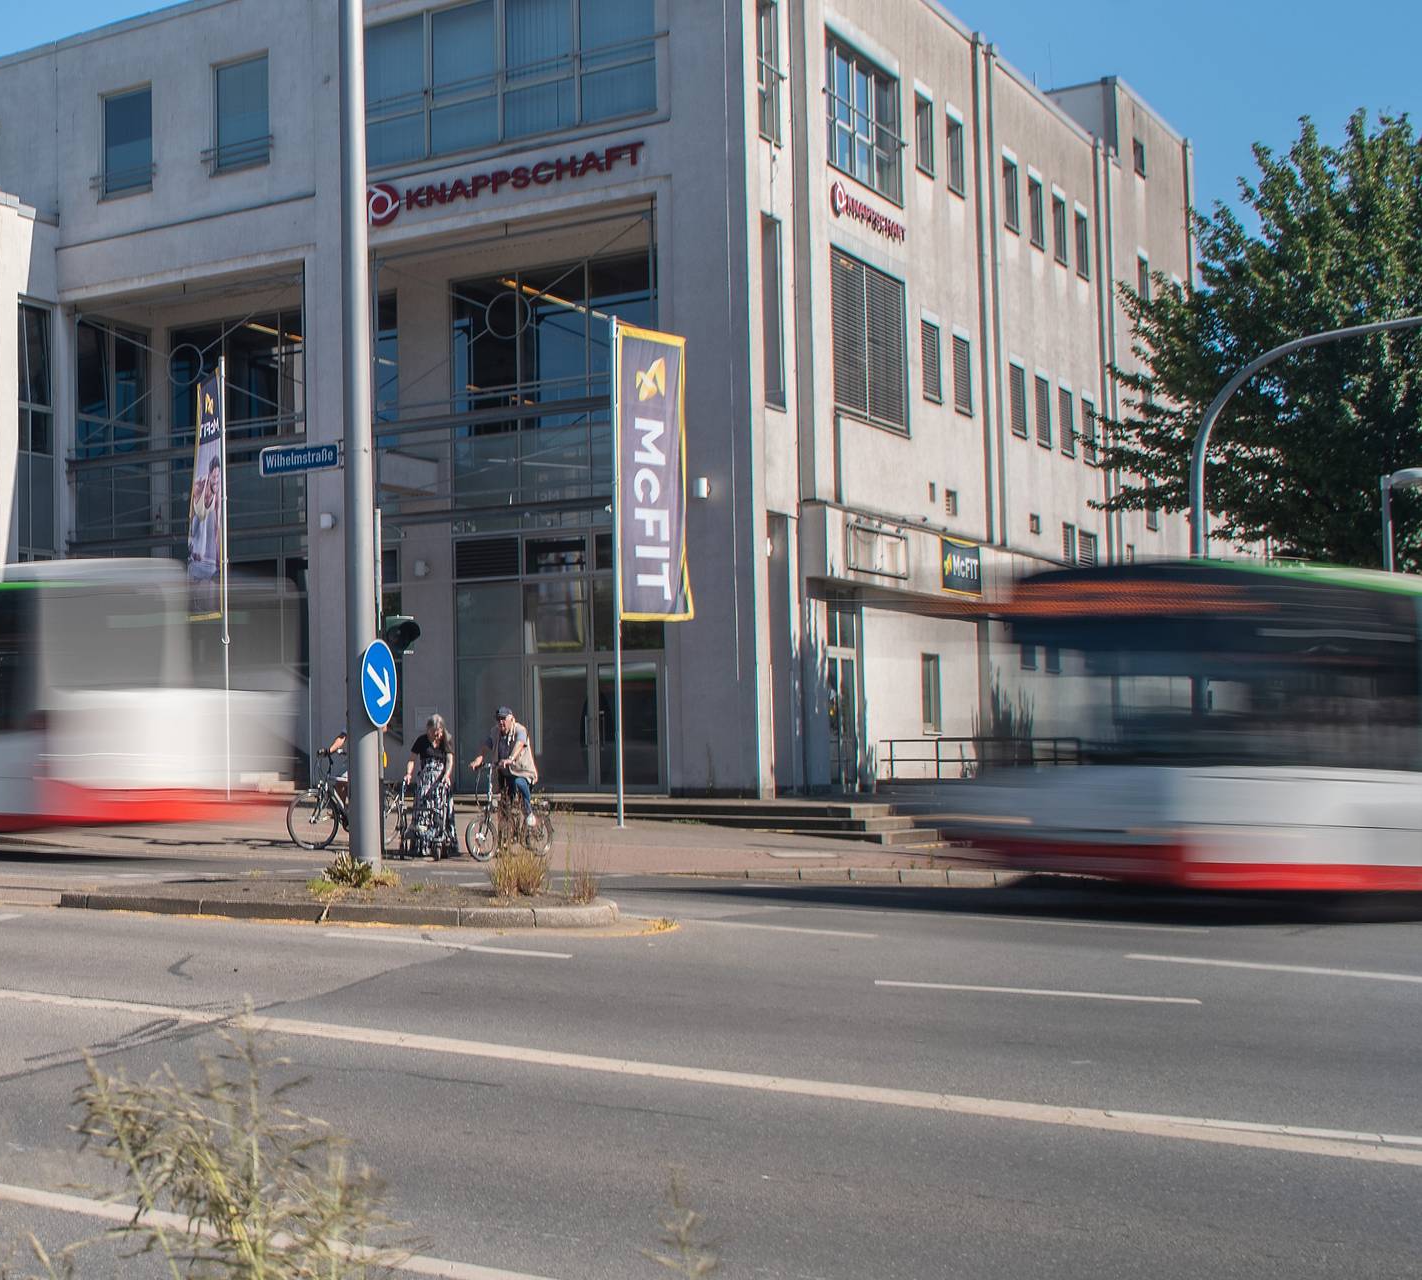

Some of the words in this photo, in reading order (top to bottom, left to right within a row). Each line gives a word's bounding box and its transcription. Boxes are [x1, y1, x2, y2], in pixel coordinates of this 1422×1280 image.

[405, 141, 645, 211] KNAPPSCHAFT
[266, 447, 334, 469] Wilhelmstraße
[634, 417, 672, 601] McFIT
[952, 553, 979, 580] McFIT
